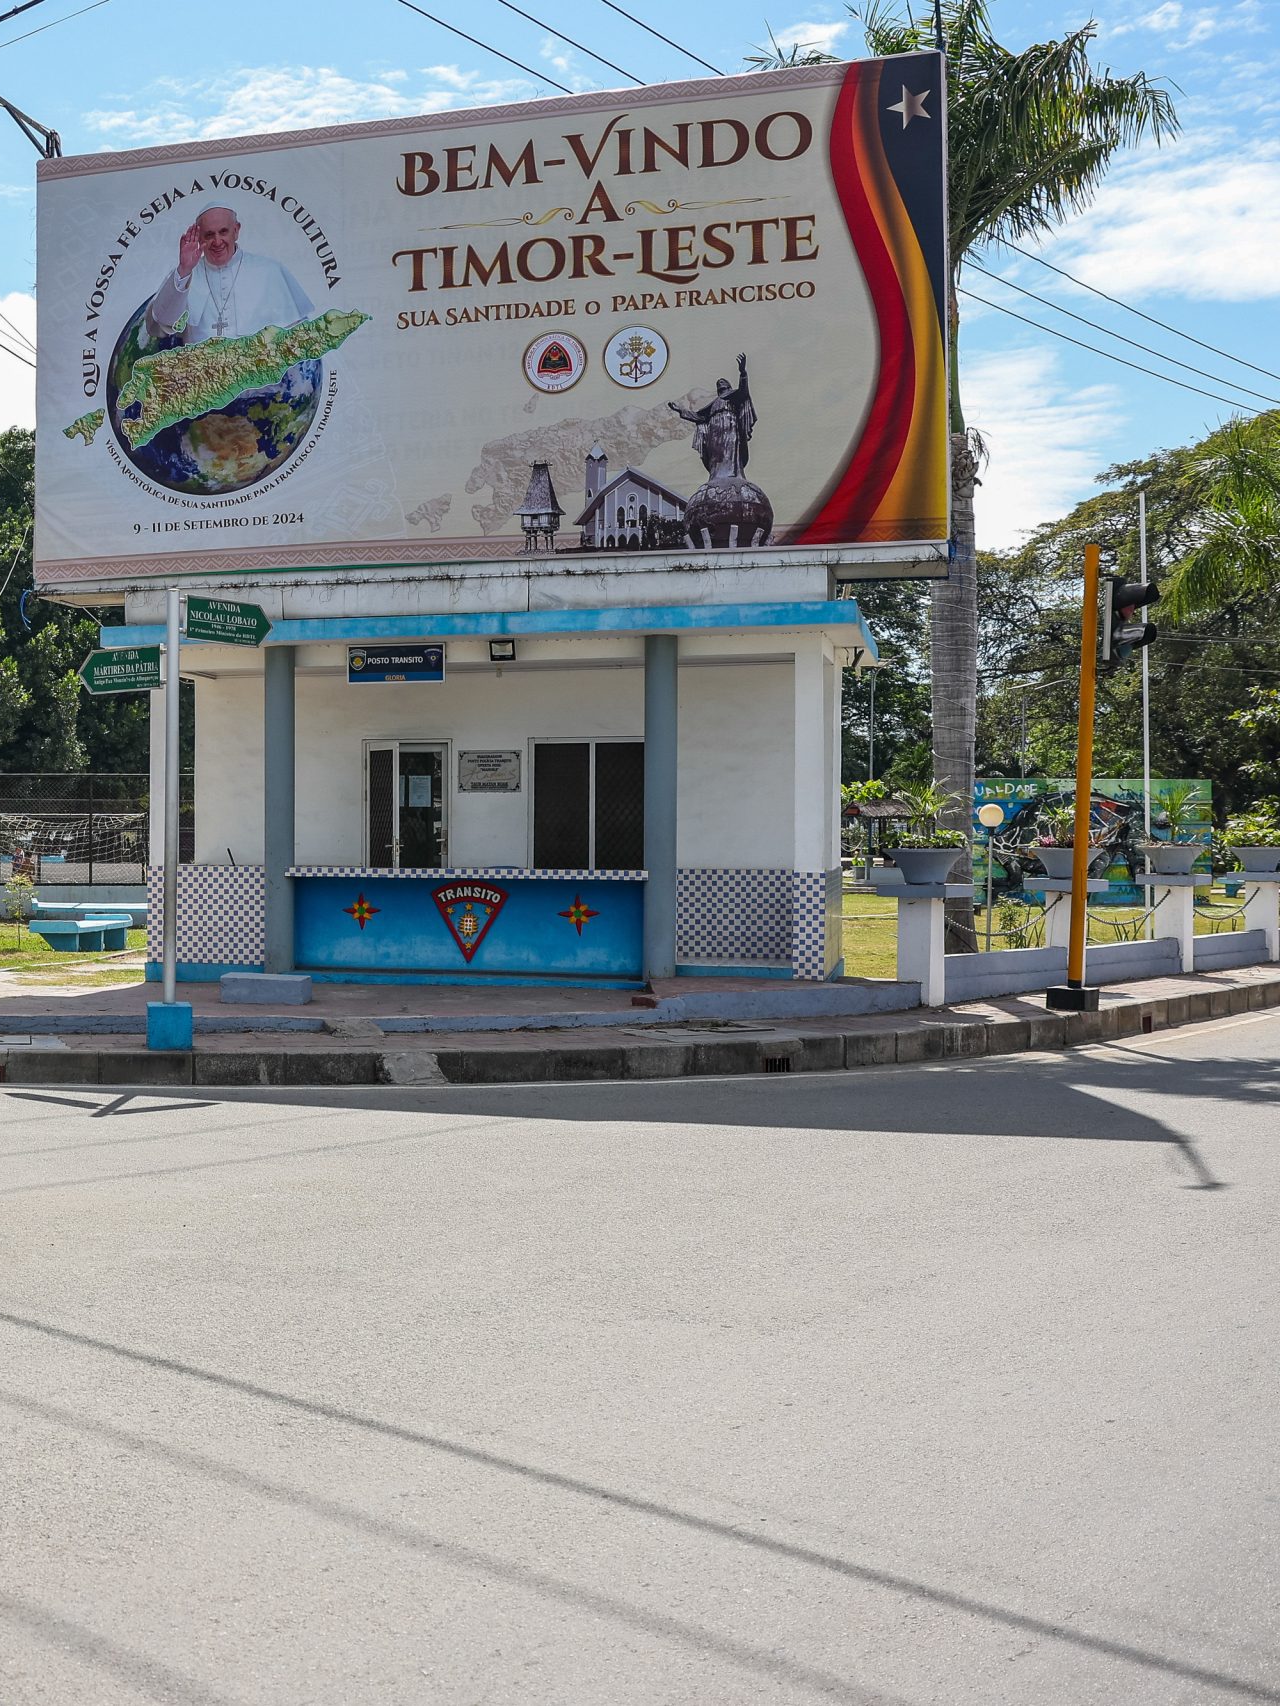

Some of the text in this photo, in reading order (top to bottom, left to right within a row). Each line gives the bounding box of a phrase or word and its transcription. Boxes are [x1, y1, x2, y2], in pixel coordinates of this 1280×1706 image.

[396, 111, 813, 197] BEM-VINDO
[575, 180, 624, 225] A
[392, 214, 820, 293] TIMOR-LESTE
[83, 168, 342, 398] QUE A VOSSA FÉ SEJA A VOSSA CULTURA
[397, 310, 441, 330] SUA
[445, 299, 576, 326] SANTIDADE
[611, 292, 670, 313] PAPA
[674, 281, 816, 308] FRANCISCO
[105, 438, 122, 467] VISITA
[121, 464, 166, 502] APOSTÓLICA
[167, 496, 180, 506] DE
[180, 499, 198, 509] SUA
[200, 493, 253, 510] SANTIDADE
[253, 483, 275, 498] PAPA
[275, 441, 316, 485] FRANCISCO
[317, 370, 338, 434] TIMOR-LESTE
[133, 523, 141, 534] 9
[165, 522, 180, 532] DE
[183, 517, 249, 531] SETEMBRO
[252, 516, 269, 526] DE
[272, 512, 304, 525] 2024
[190, 610, 257, 626] NICOLAU LOBATO
[208, 601, 241, 613] AVENIDA
[94, 660, 159, 676] MÁRTIRES DA PÁTRIA
[367, 656, 424, 665] POSTO TRANSITO
[437, 886, 501, 903] TRANSITO
